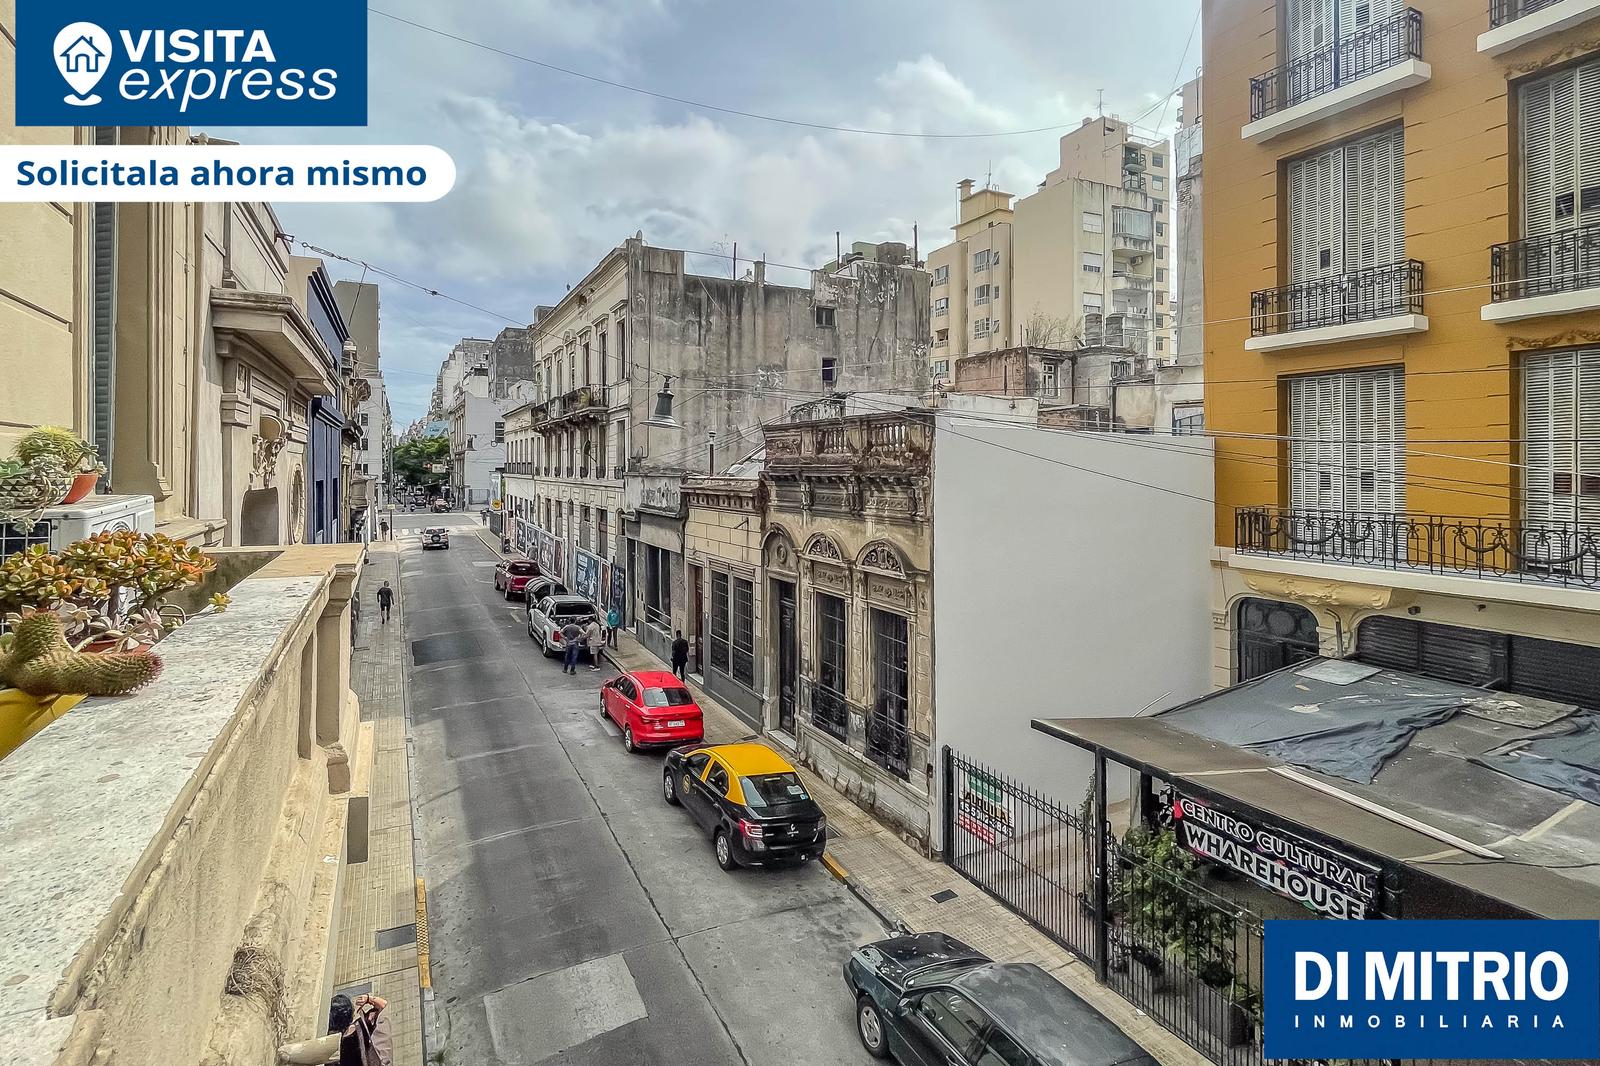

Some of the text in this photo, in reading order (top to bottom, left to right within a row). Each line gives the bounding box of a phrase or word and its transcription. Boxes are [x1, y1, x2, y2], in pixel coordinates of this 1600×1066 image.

[1180, 798, 1373, 898] CENTRO CULTURAL
[1183, 820, 1365, 920] WHAREHOUSE
